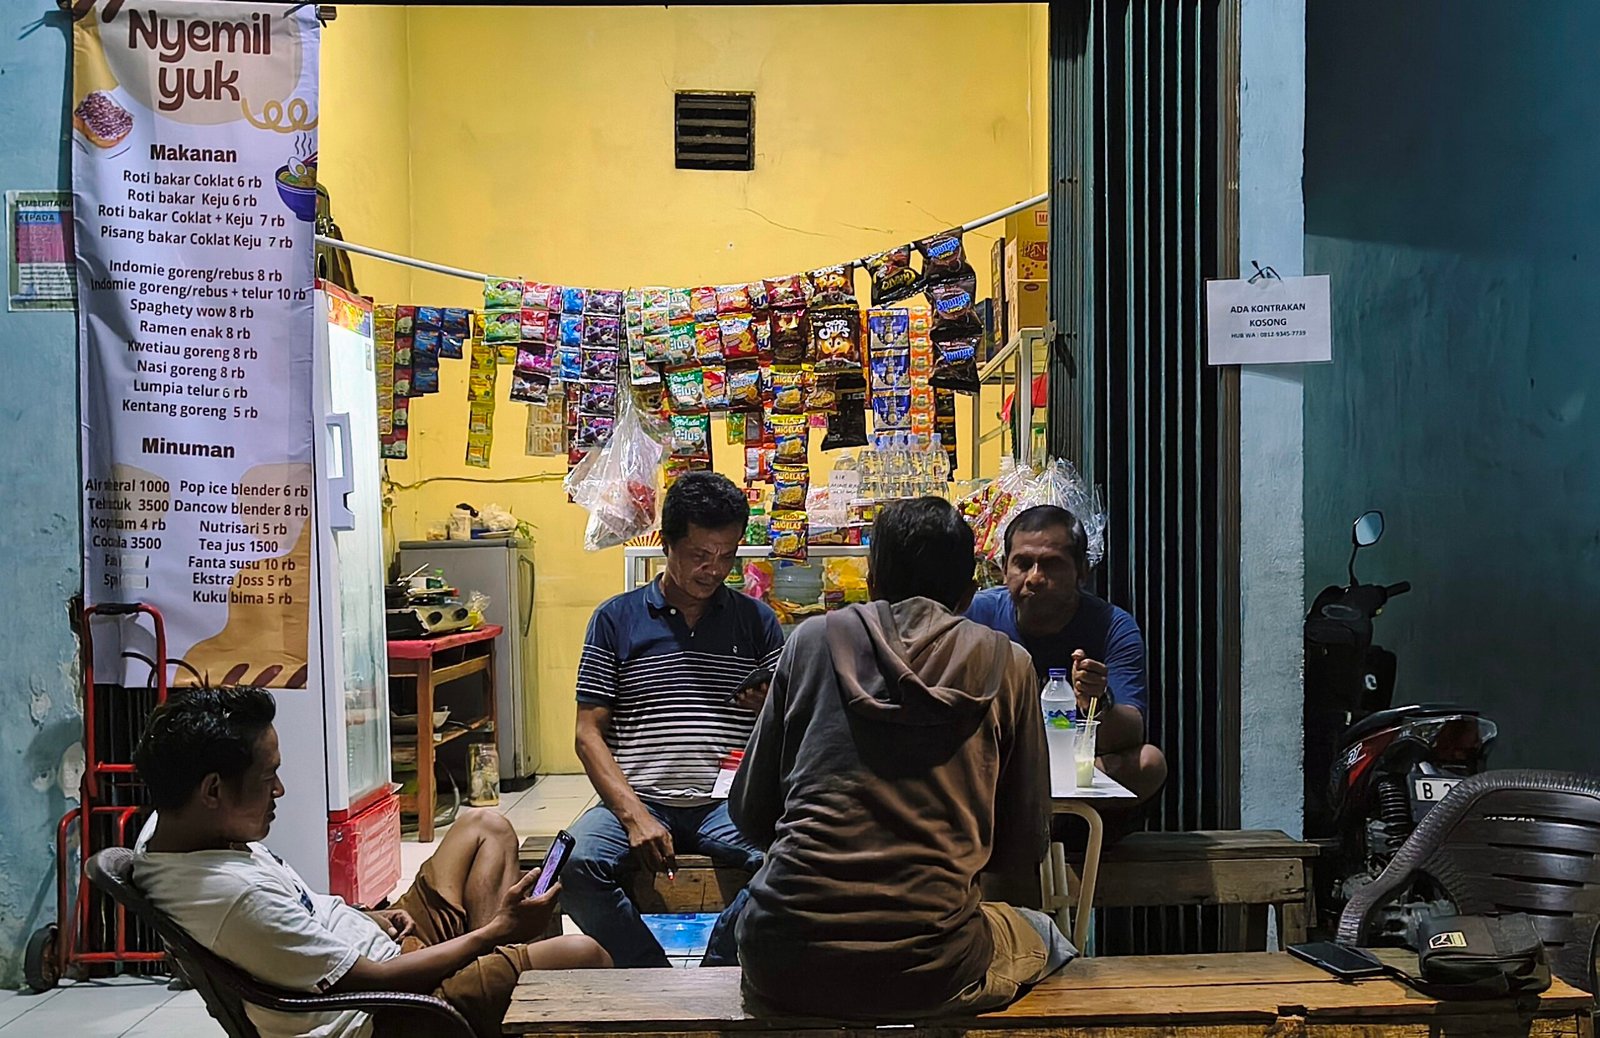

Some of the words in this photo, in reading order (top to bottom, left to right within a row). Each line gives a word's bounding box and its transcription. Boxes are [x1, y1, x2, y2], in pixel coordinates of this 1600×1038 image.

[128, 9, 271, 63] Nyemil
[158, 61, 240, 111] yuk
[150, 144, 237, 163] Makanan
[123, 170, 150, 183] Roti
[154, 172, 190, 186] bakar
[194, 174, 233, 187] Coklat
[237, 175, 245, 188] 6
[248, 175, 262, 189] rb
[128, 189, 154, 203] Roti
[159, 190, 195, 205] bakar
[202, 193, 229, 209] Keju
[233, 194, 240, 207] 6
[243, 194, 257, 207] rb
[98, 205, 124, 218] Roti
[129, 206, 167, 222] bakar
[171, 210, 211, 225] Coklat
[226, 212, 253, 229] Keju
[260, 214, 267, 226] 7
[271, 214, 285, 227] rb
[101, 225, 144, 243] Pisang
[148, 230, 187, 245] bakar
[190, 233, 230, 246] Coklat
[234, 234, 261, 250] Keju
[269, 236, 276, 247] 7
[279, 235, 293, 248] rb
[109, 260, 165, 276] Indomie
[168, 266, 254, 282] goreng/rebus
[258, 269, 265, 281] 8
[268, 269, 282, 282] rb
[90, 278, 136, 291] Indomie
[139, 282, 228, 298] goreng/rebus
[242, 287, 273, 300] telur
[277, 288, 291, 300] 10
[293, 288, 306, 300] rb
[130, 299, 193, 319] Spaghety
[197, 307, 226, 318] wow
[229, 306, 236, 318] 8
[240, 306, 253, 319] rb
[936, 292, 971, 312] Sponge
[1230, 306, 1249, 314] ADA
[1251, 303, 1306, 313] KONTRAKAN
[140, 320, 187, 336] Ramen
[191, 326, 222, 339] enak
[226, 327, 234, 339] 8
[237, 327, 250, 339] rb
[1249, 318, 1287, 327] KOSONG
[128, 340, 180, 355] Kwetiau
[184, 346, 230, 361] goreng
[233, 348, 240, 359] 8
[244, 348, 257, 360] rb
[137, 360, 167, 373] Nasi
[170, 365, 217, 380] goreng
[220, 367, 227, 378] 8
[231, 366, 245, 379] rb
[133, 379, 183, 396] Lumpia
[187, 385, 219, 397] telur
[222, 388, 230, 398] 6
[234, 386, 248, 399] rb
[122, 399, 177, 416] Kentang
[180, 405, 227, 420] goreng
[233, 407, 241, 418] 5
[244, 406, 258, 418] rb
[142, 437, 235, 459] Minuman
[140, 480, 169, 493] 1000
[180, 480, 205, 496] Pop
[209, 481, 227, 495] ice
[231, 483, 281, 496] blender
[284, 485, 291, 497] 6
[295, 485, 308, 497] rb
[138, 499, 169, 512] 3500
[174, 500, 227, 514] Dancow
[231, 502, 281, 516] blender
[284, 504, 291, 516] 8
[295, 504, 308, 516] rb
[140, 518, 148, 531] 4
[152, 517, 166, 531] rb
[200, 521, 259, 535] Nutrisari
[263, 524, 270, 535] 5
[274, 523, 287, 535] rb
[131, 537, 161, 549] 3500
[199, 538, 222, 551] Tea
[225, 539, 245, 554] jus
[250, 540, 279, 553] 1500
[188, 556, 226, 569] Fanta
[230, 559, 260, 570] susu
[264, 559, 278, 570] 10
[282, 558, 296, 571] rb
[193, 573, 234, 586] Ekstra
[237, 575, 264, 588] Joss
[267, 575, 274, 586] 5
[278, 574, 292, 587] rb
[193, 591, 227, 604] Kuku
[231, 592, 264, 605] bima
[267, 593, 274, 604] 5
[279, 592, 292, 605] rb
[1422, 782, 1433, 799] B
